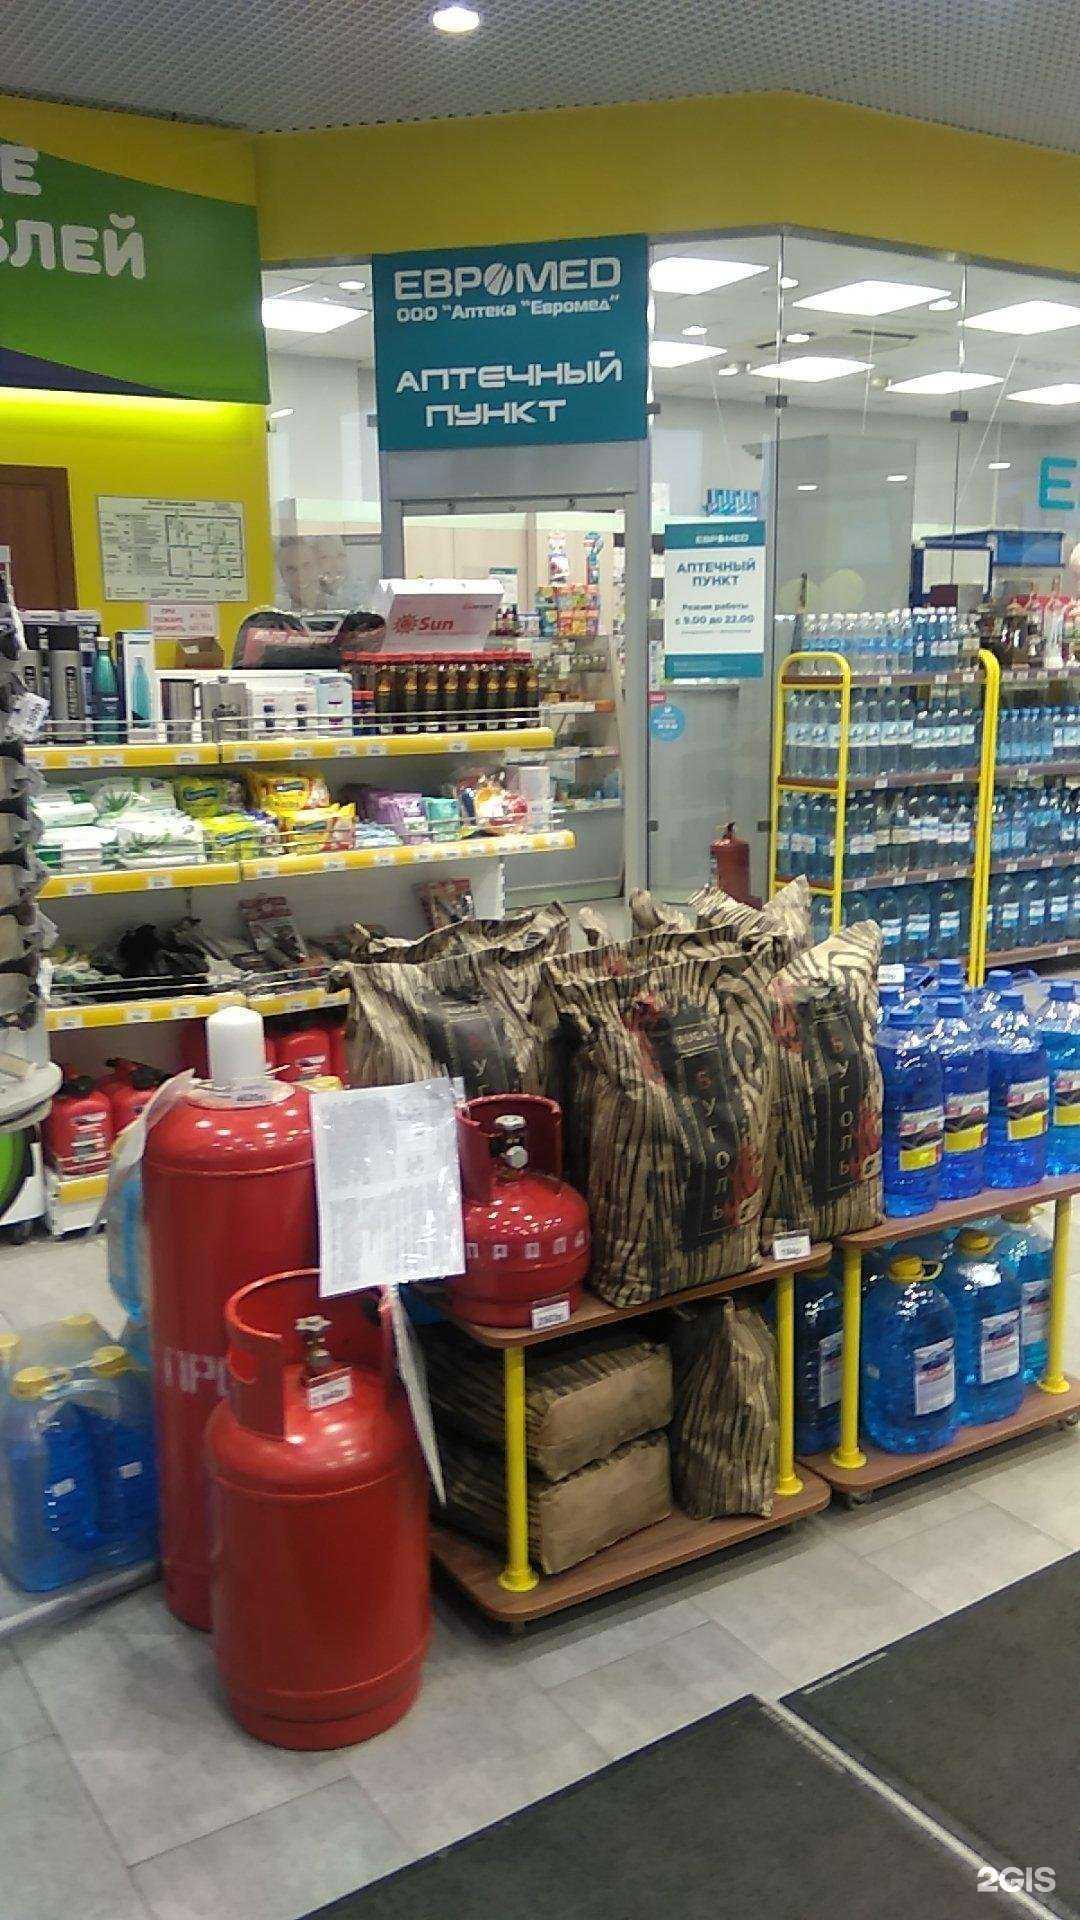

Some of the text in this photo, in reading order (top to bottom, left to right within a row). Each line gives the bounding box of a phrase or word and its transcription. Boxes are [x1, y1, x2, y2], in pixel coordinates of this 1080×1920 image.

[0, 212, 147, 280] ЛЕЙ
[396, 305, 438, 323] ООО
[395, 349, 624, 394] АПТЕЧНЫЙ
[425, 399, 567, 428] ПУНКТ
[676, 557, 756, 574] АПТЕЧНЫЙ
[692, 575, 739, 587] ПУНКТ
[419, 615, 455, 632] Sun
